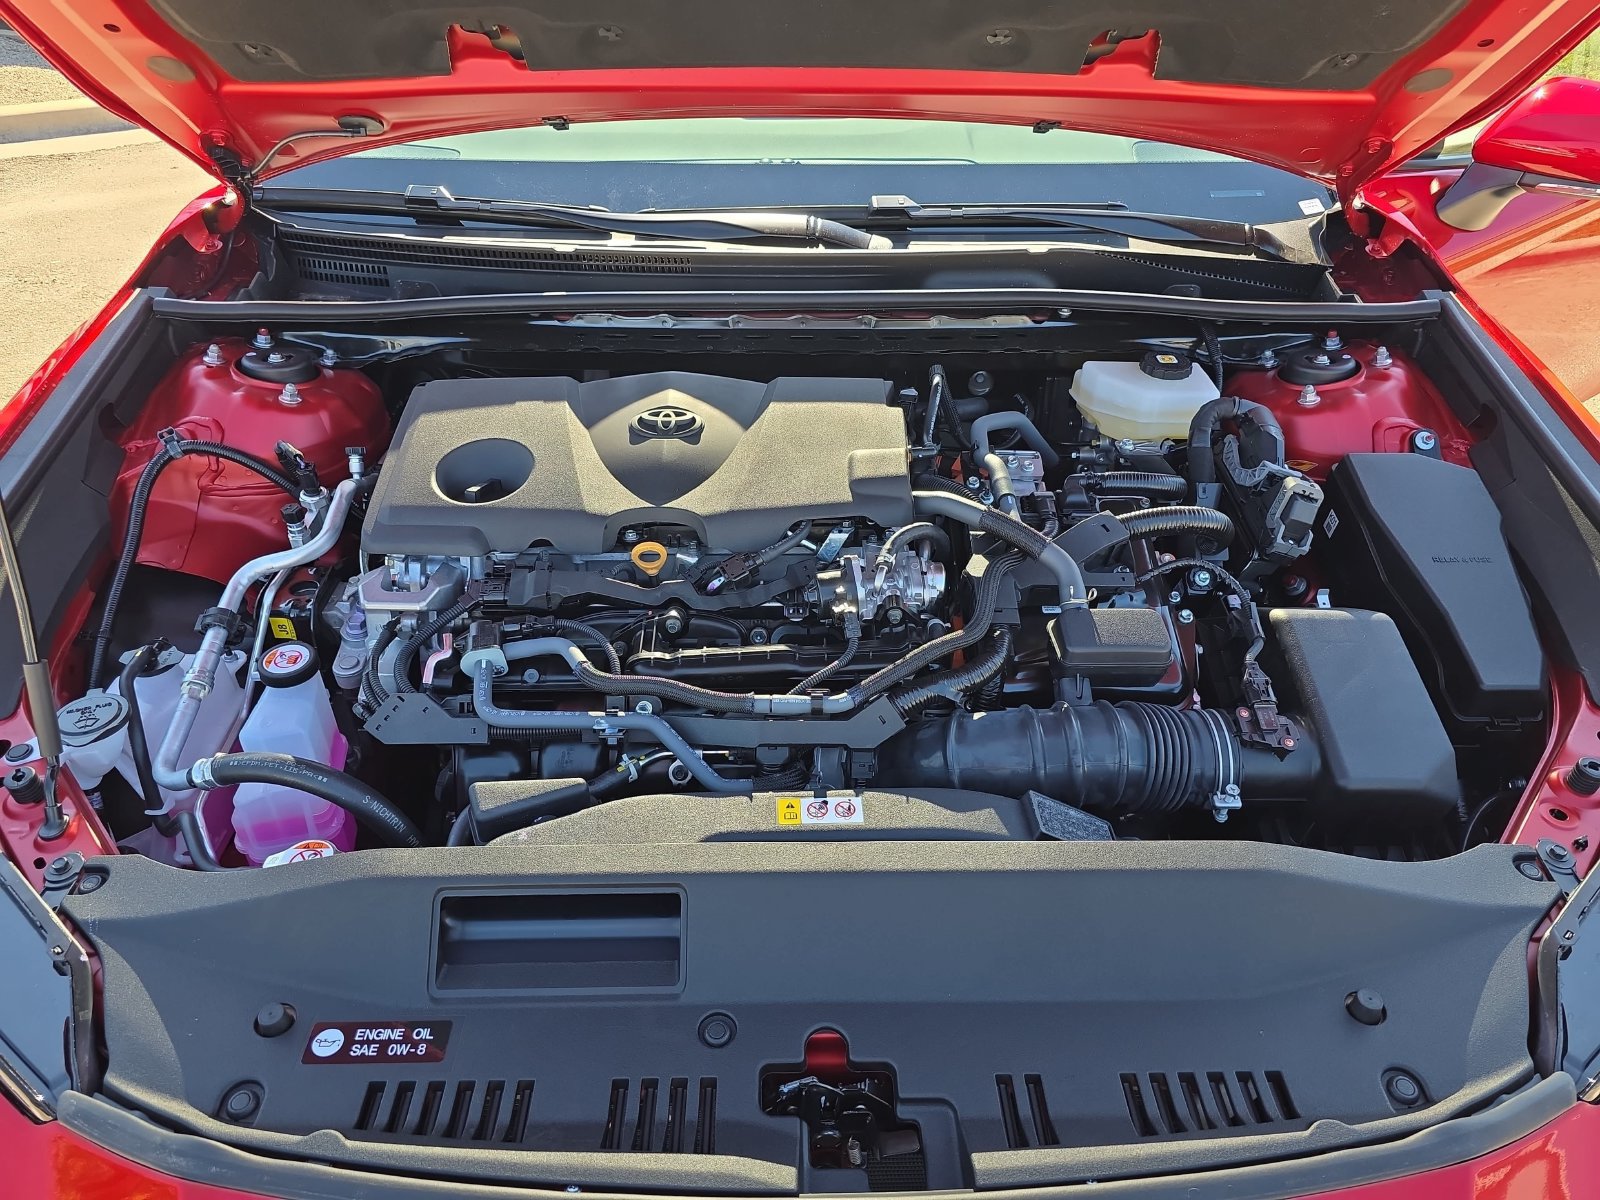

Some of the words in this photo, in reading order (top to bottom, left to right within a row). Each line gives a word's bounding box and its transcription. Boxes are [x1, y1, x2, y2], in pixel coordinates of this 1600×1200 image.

[354, 1028, 405, 1040] ENGINE
[412, 1028, 434, 1040] OIL
[349, 1044, 379, 1056] SAE
[387, 1043, 427, 1056] 0W-8
